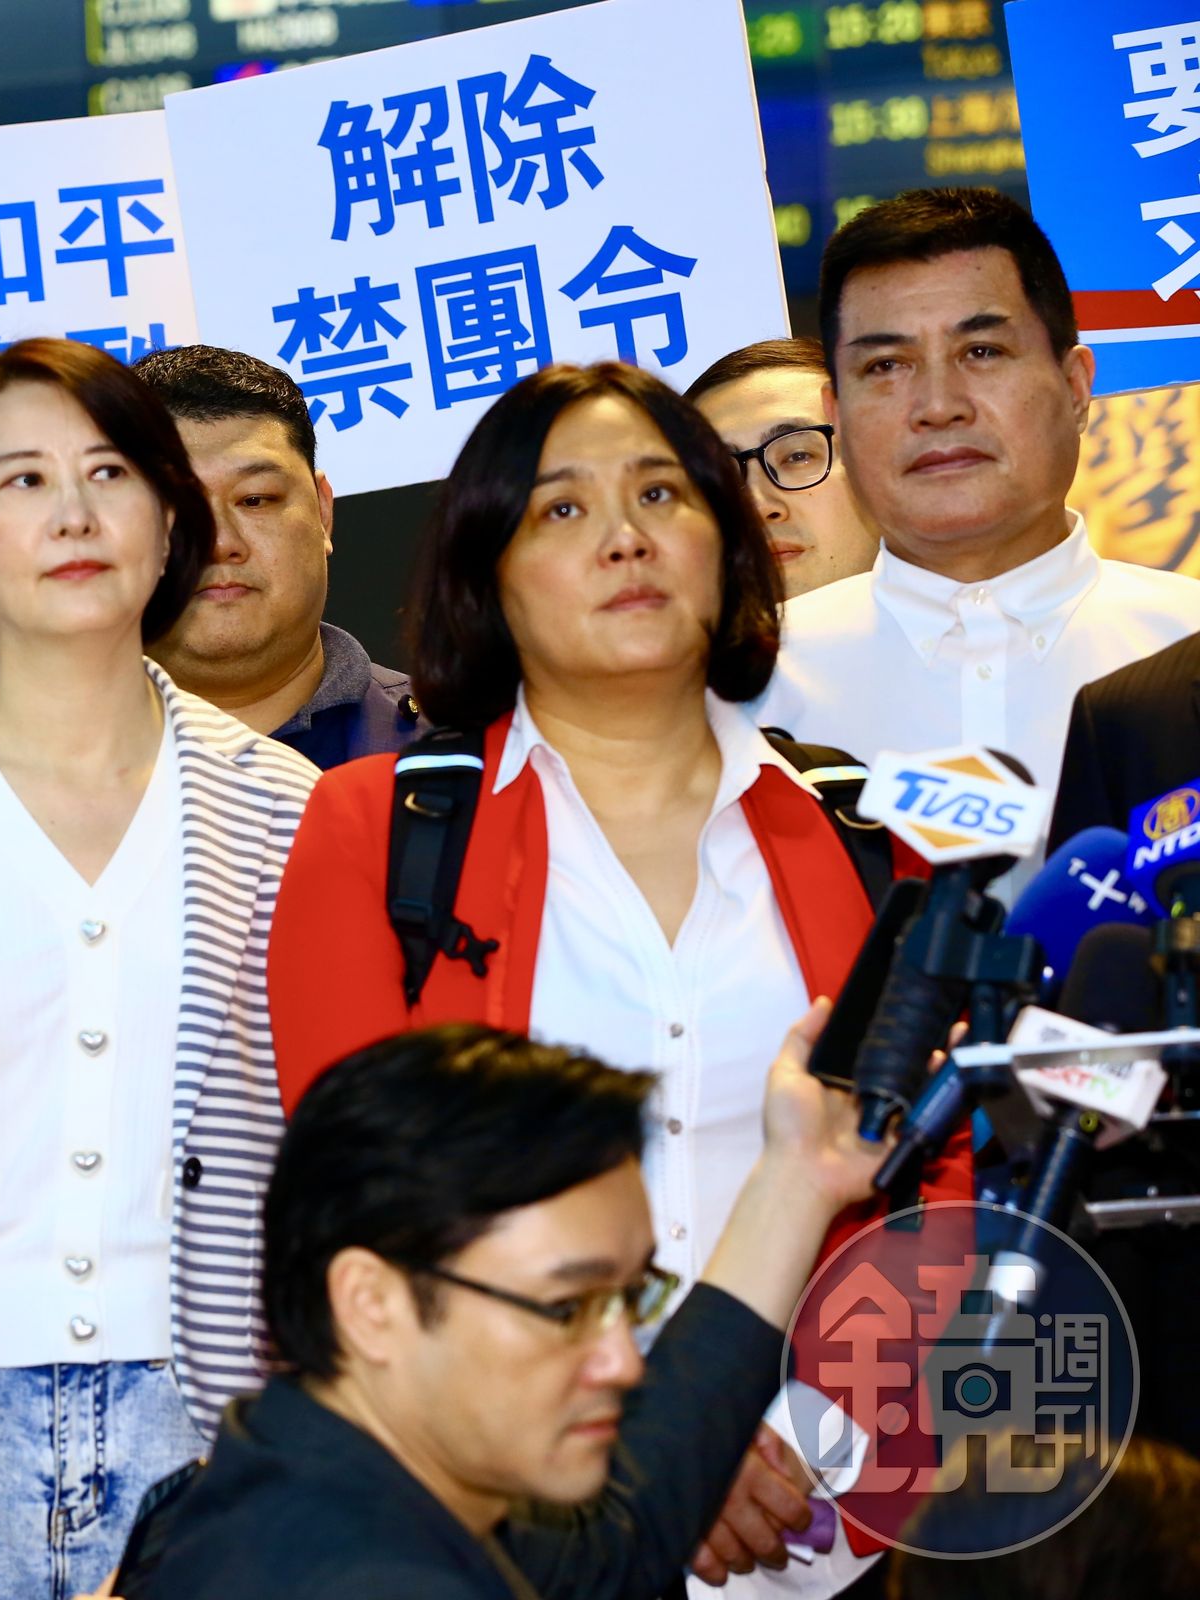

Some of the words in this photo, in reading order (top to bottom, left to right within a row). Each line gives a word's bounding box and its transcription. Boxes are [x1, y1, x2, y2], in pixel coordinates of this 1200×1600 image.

[317, 54, 604, 241] 解除
[272, 225, 697, 432] 禁團令
[893, 770, 1024, 836] TVBS
